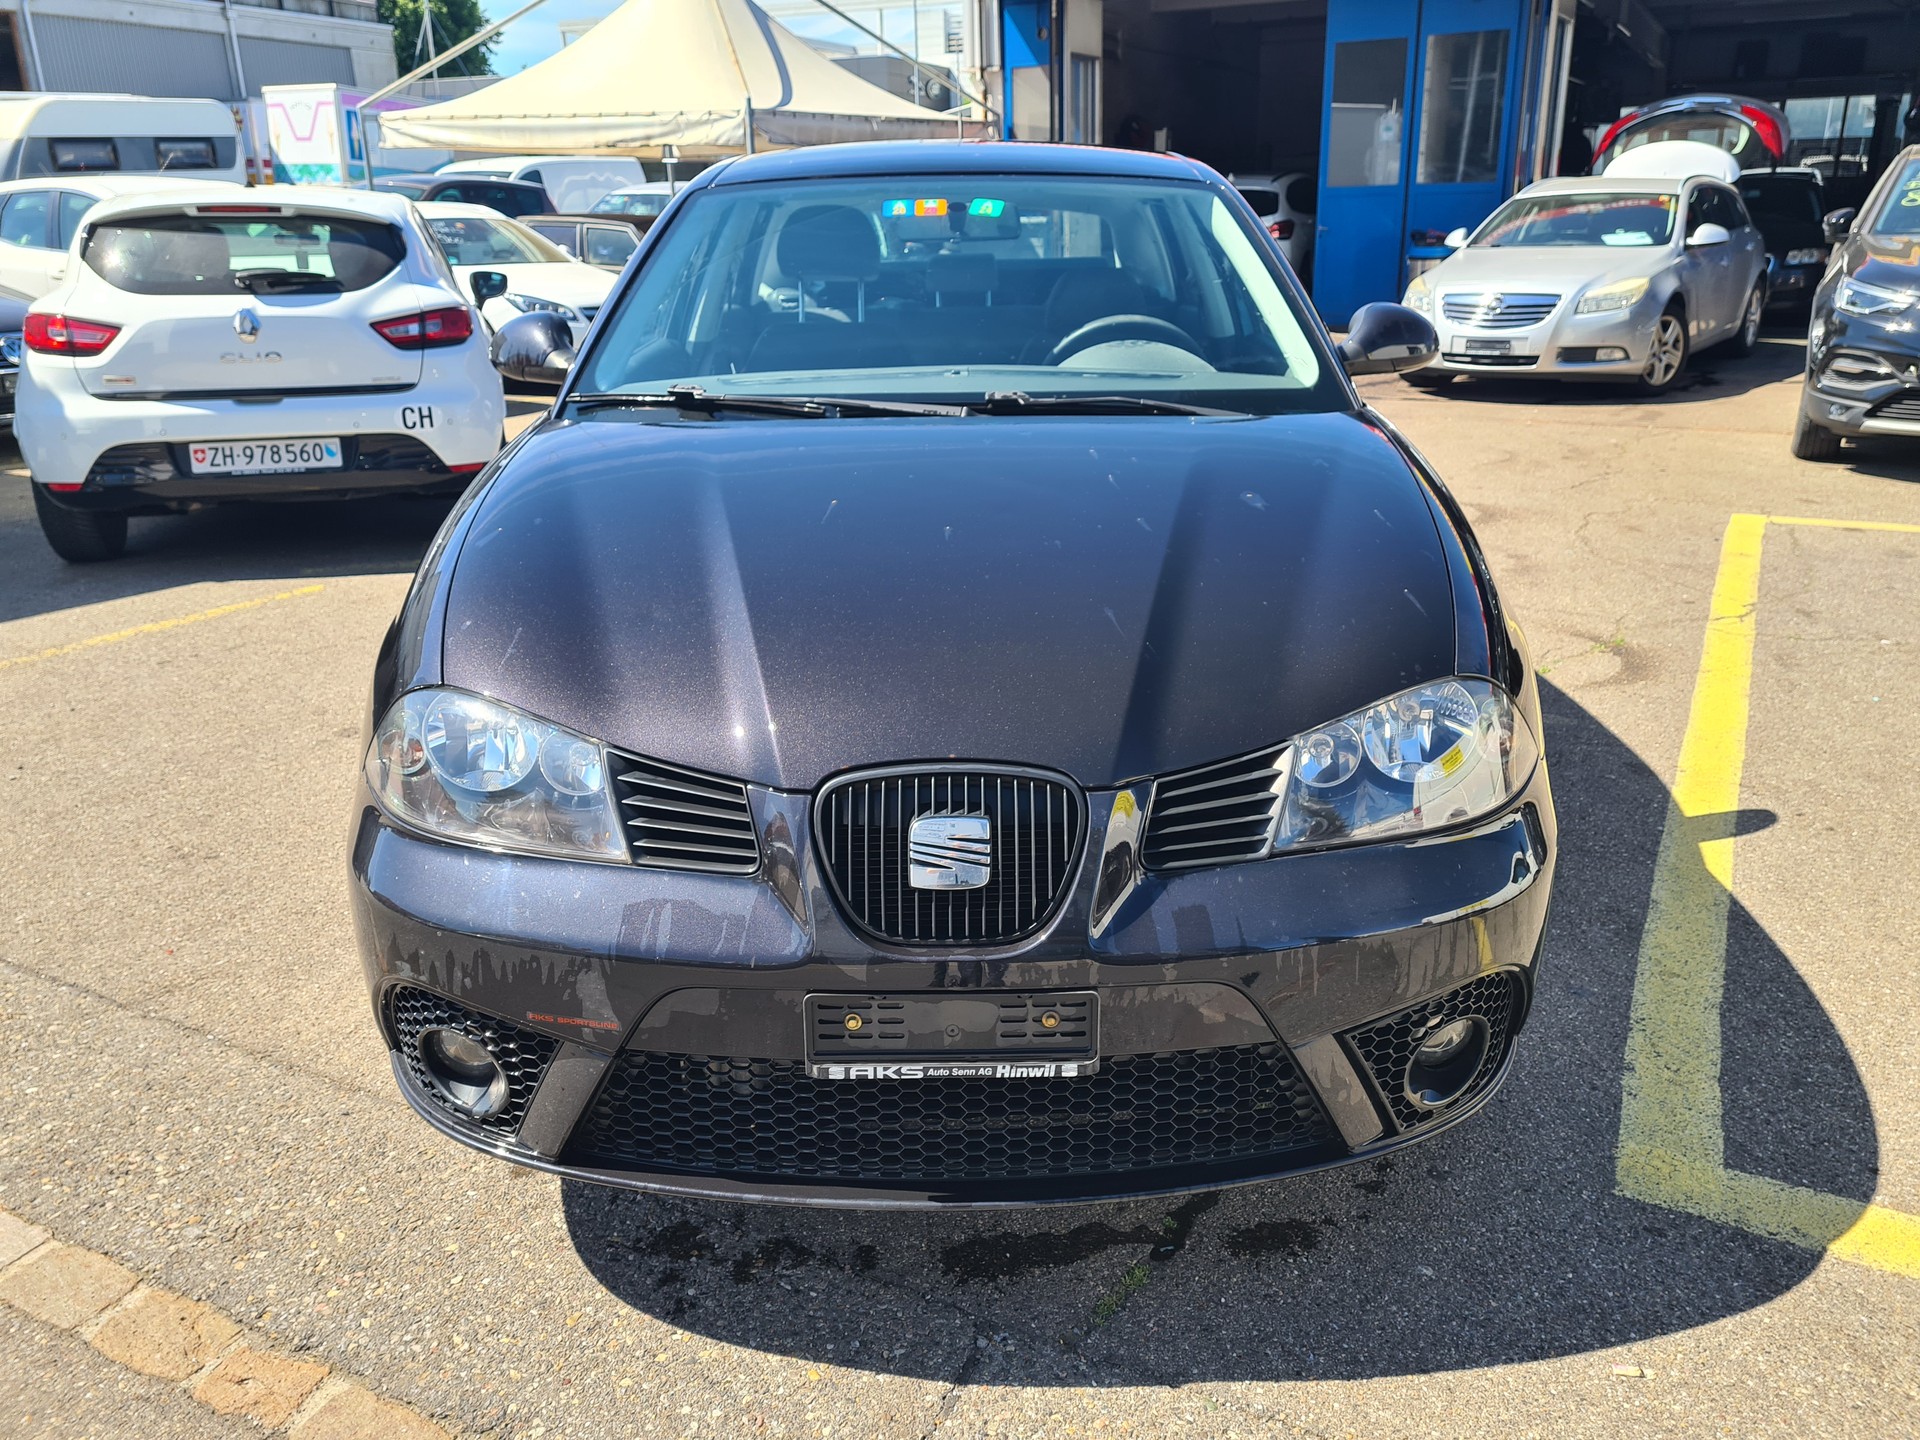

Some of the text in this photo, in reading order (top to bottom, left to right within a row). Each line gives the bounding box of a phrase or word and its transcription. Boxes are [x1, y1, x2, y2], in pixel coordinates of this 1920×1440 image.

[401, 406, 434, 430] CH
[557, 1017, 618, 1030] SPORTSLINE
[849, 1064, 1057, 1080] AKS Auto Senn AG Hinwil
